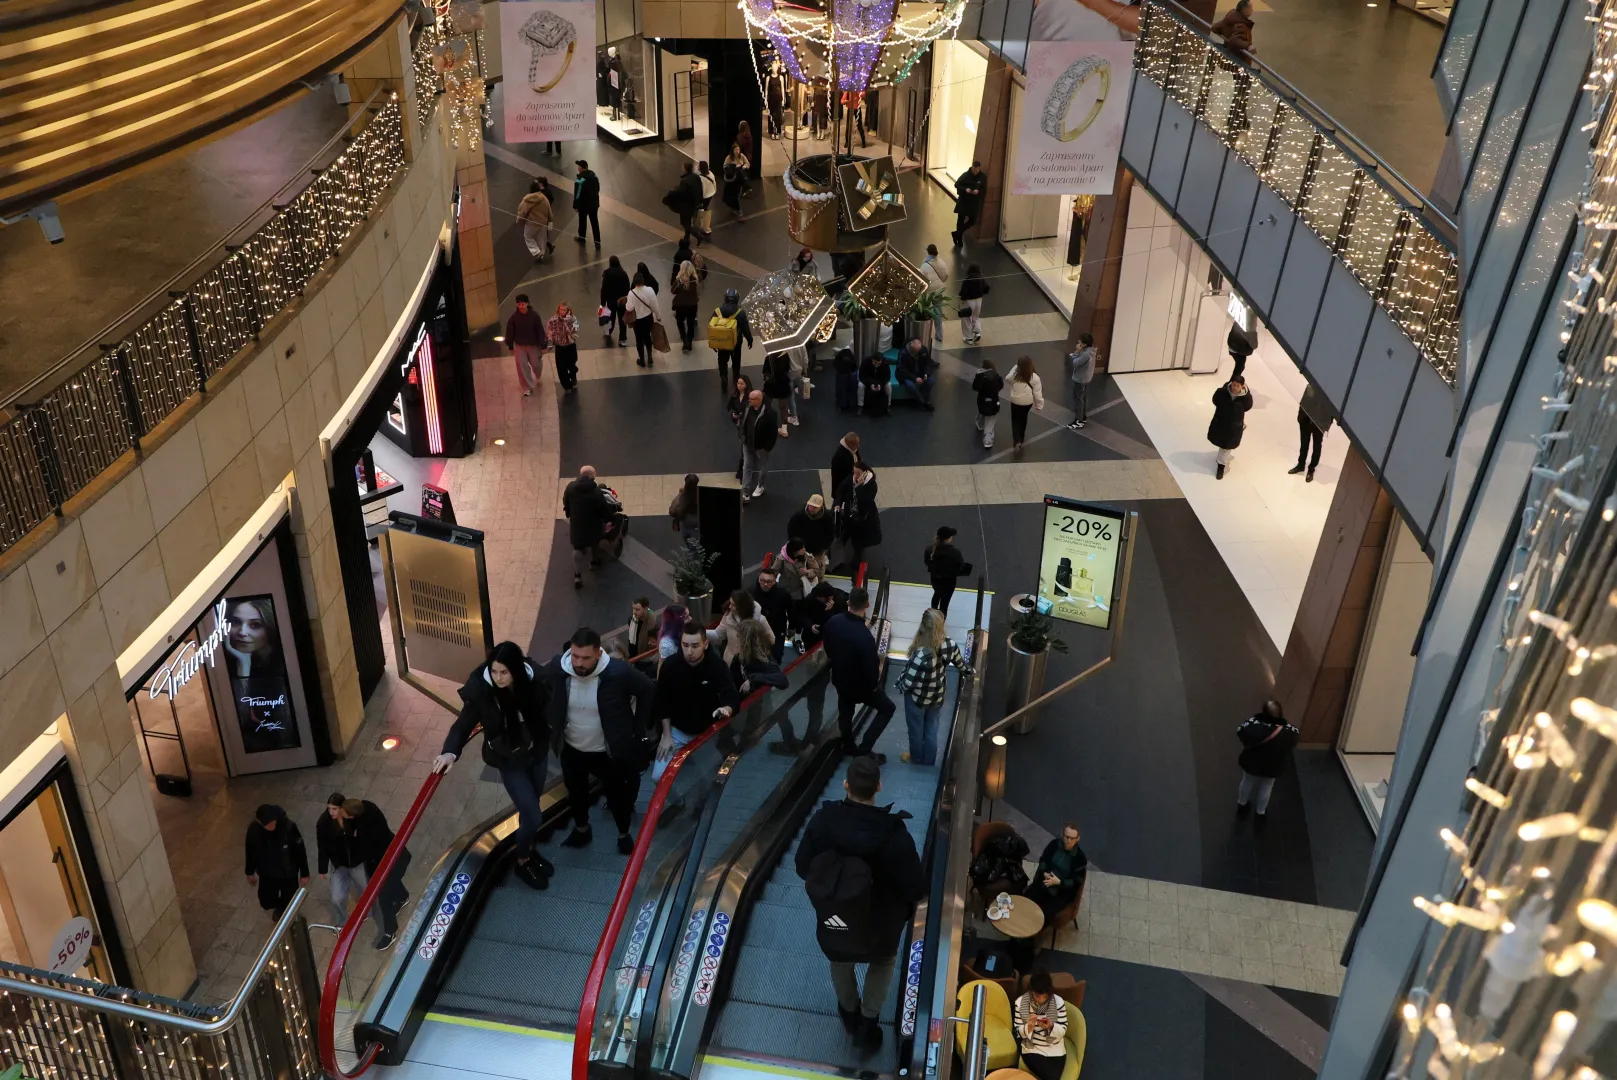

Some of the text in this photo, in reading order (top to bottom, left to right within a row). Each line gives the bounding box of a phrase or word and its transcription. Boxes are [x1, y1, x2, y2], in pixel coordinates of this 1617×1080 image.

[526, 102, 576, 112] Zapraszamy
[516, 112, 586, 122] do salonów Apart
[536, 124, 572, 134] poziomie
[1040, 152, 1096, 162] Zapraszamy
[1040, 164, 1078, 172] salonów
[1080, 164, 1104, 173] Apart
[1045, 176, 1088, 186] poziomie
[1053, 516, 1112, 540] -20%
[1058, 607, 1087, 617] DOUGLAS
[150, 598, 232, 700] Triumph
[240, 694, 285, 708] Triumph
[53, 926, 90, 969] -50%
